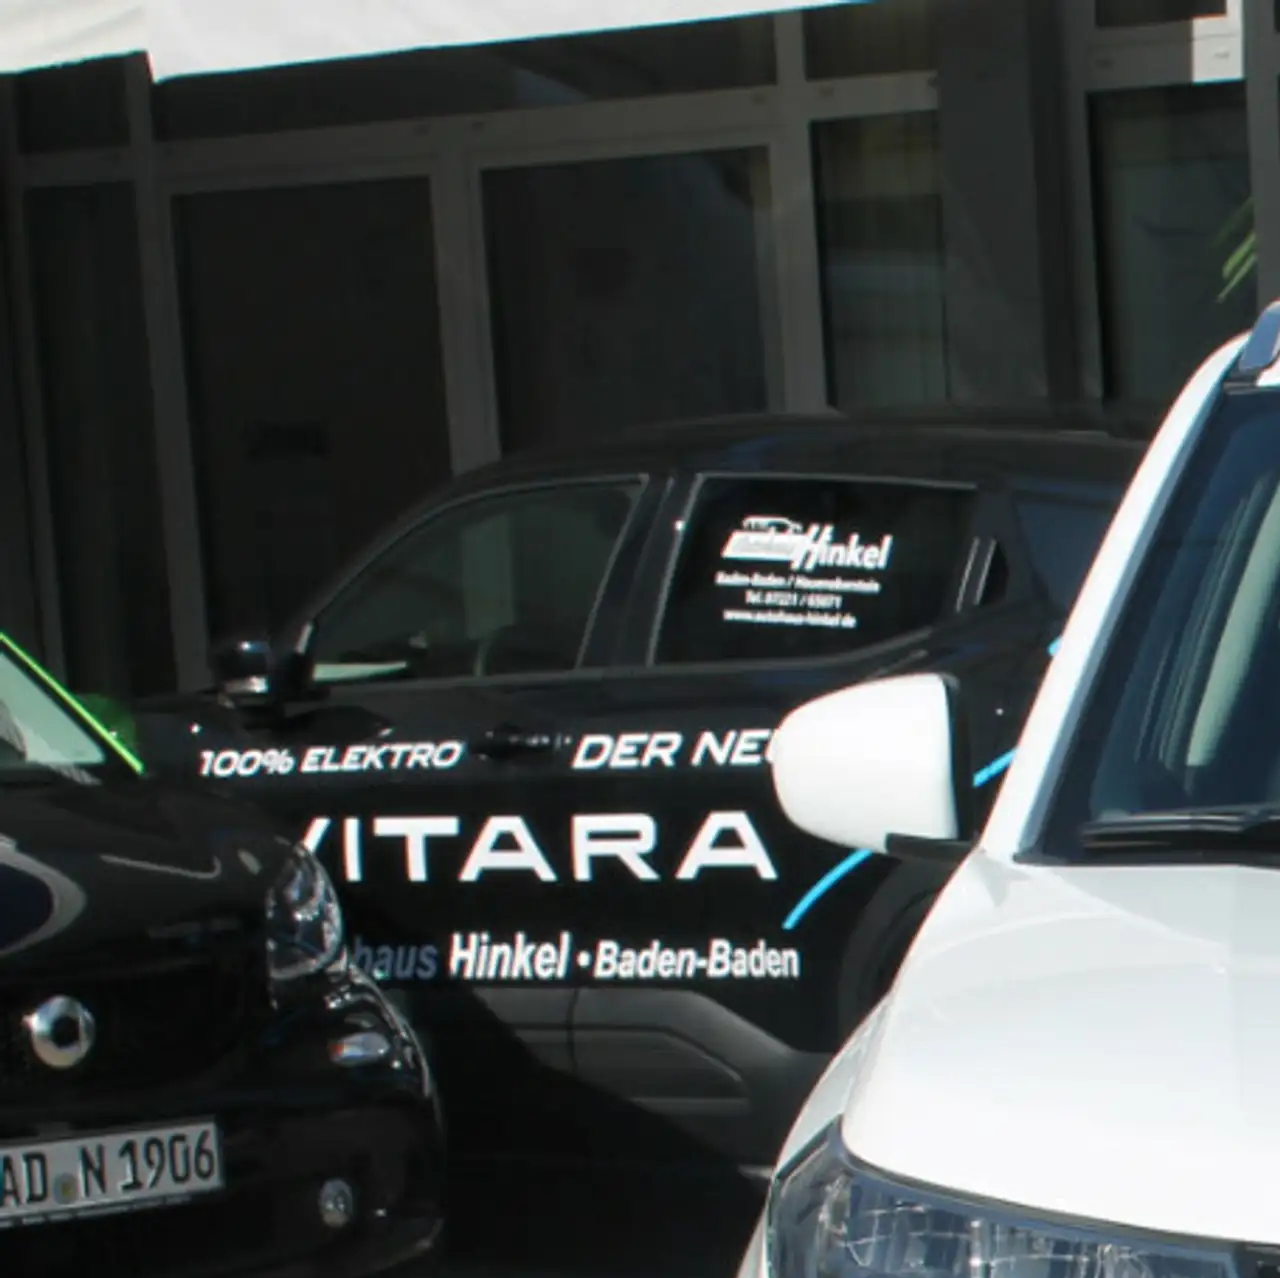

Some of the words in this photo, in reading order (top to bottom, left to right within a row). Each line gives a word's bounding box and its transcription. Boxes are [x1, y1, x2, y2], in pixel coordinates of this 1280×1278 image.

[790, 523, 892, 570] Hinkel
[200, 748, 295, 777] 100%
[301, 741, 464, 773] ELEKTRO
[571, 731, 683, 769] DER
[691, 728, 775, 767] NE
[354, 935, 438, 979] haus
[450, 930, 571, 980] Hinkel
[594, 938, 800, 979] Baden-Baden
[0, 1152, 48, 1208] AD
[78, 1143, 107, 1198] N
[118, 1129, 215, 1191] 1906
